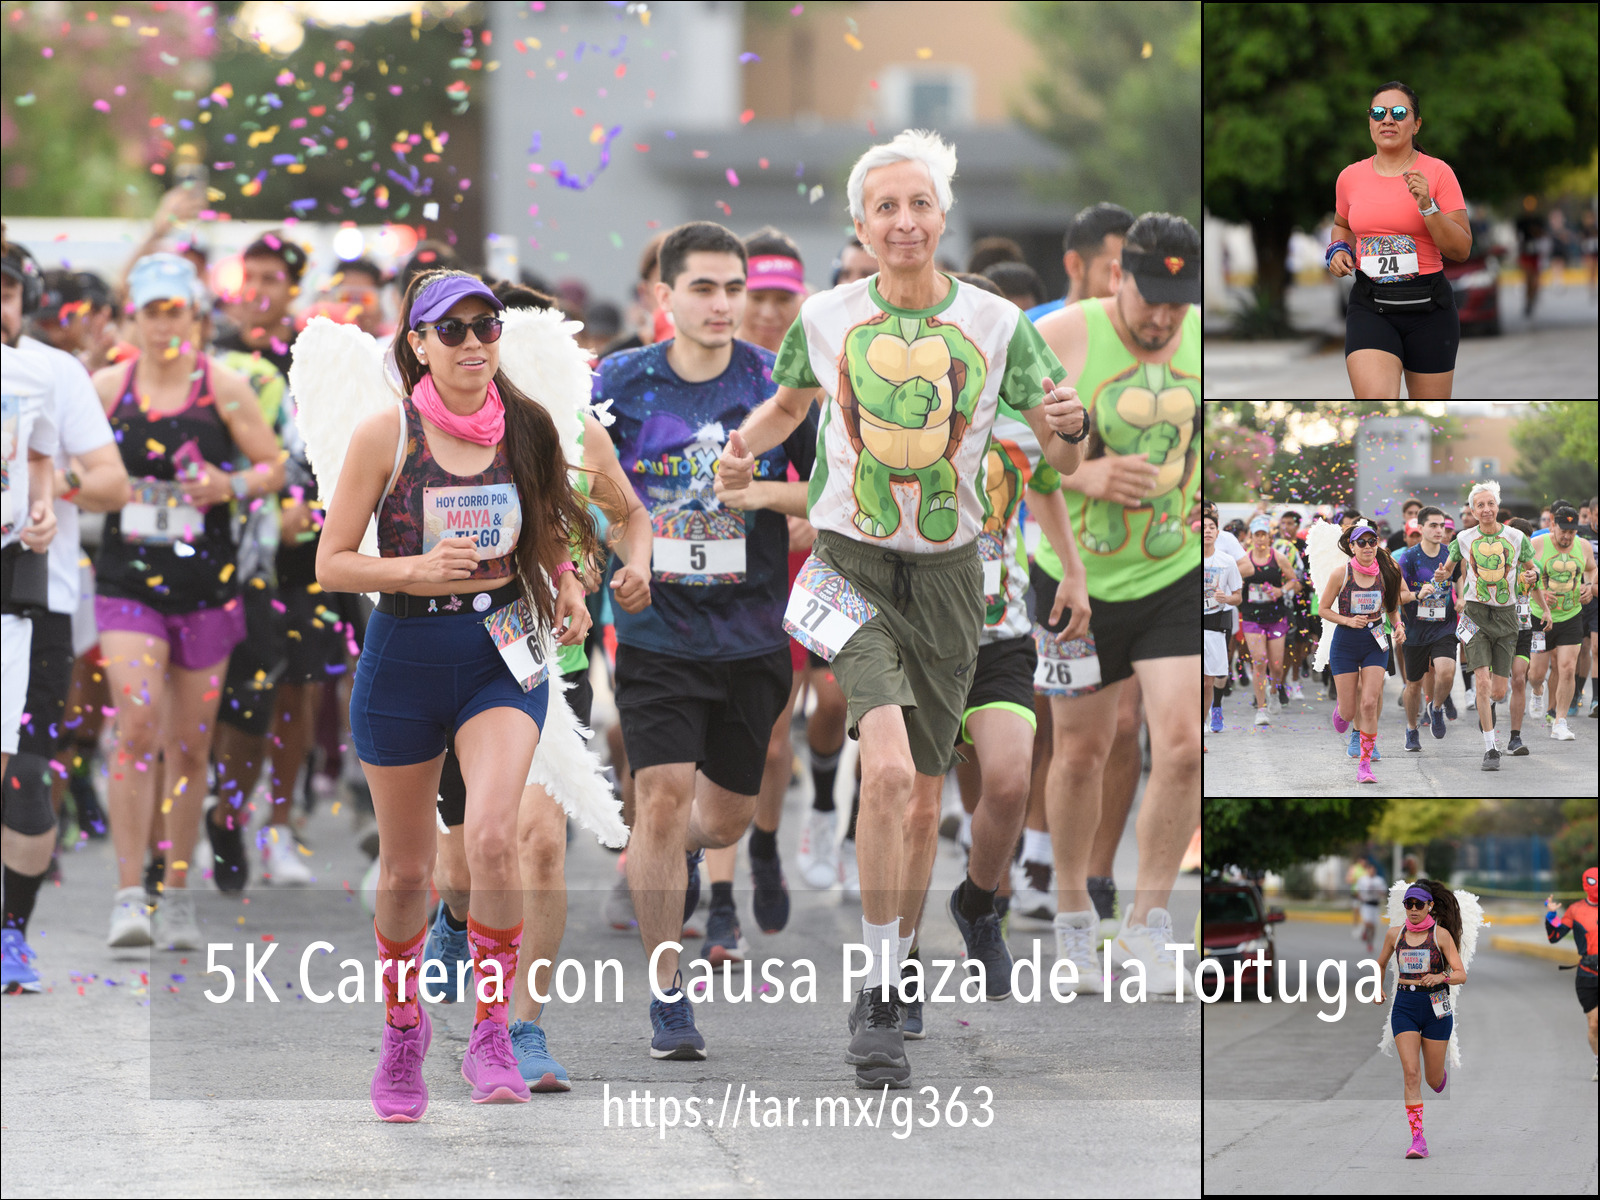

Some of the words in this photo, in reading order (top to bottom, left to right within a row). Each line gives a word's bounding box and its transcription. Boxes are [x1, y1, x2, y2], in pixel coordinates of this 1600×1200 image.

[1378, 256, 1399, 274] 24
[436, 496, 456, 508] HOY
[458, 494, 489, 507] CORRO
[491, 493, 508, 505] POR
[447, 509, 491, 529] MAYA
[493, 513, 502, 526] &
[690, 544, 707, 571] 5
[799, 598, 832, 632] 27
[1429, 608, 1435, 617] 5
[526, 634, 546, 666] 6
[1044, 661, 1072, 685] 26
